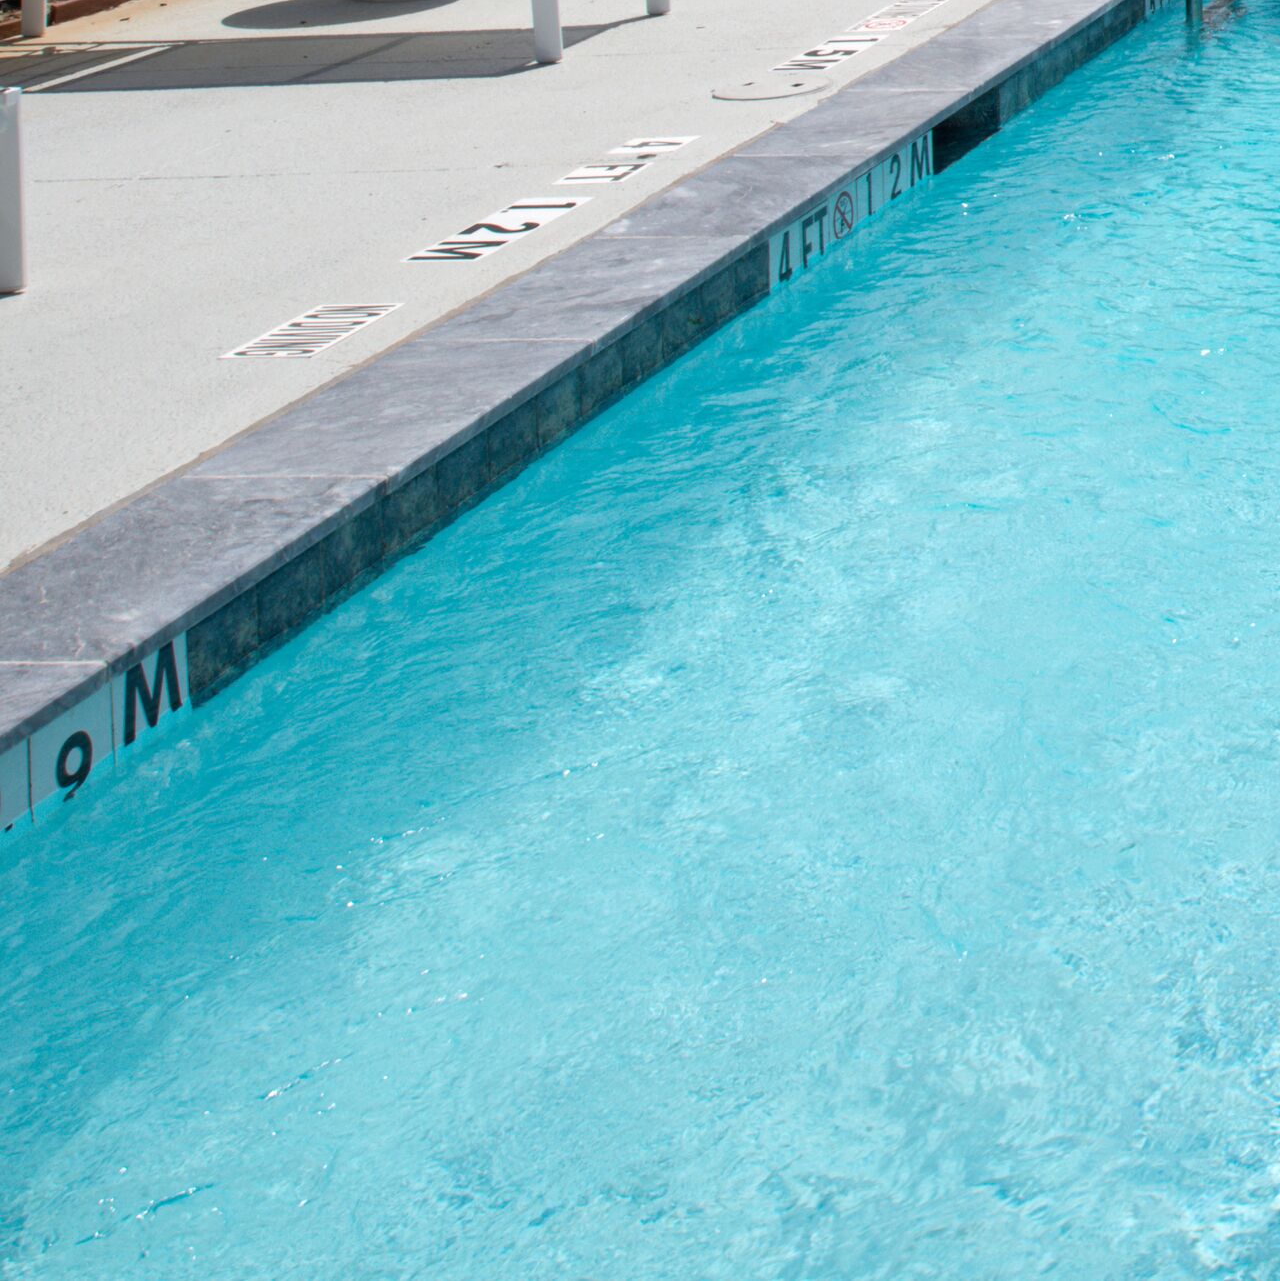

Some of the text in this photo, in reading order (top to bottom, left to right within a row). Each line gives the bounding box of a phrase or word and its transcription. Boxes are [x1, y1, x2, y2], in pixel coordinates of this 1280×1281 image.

[779, 206, 828, 282] 4 FT
[233, 304, 397, 356] NO DIVING
[124, 640, 183, 747] M
